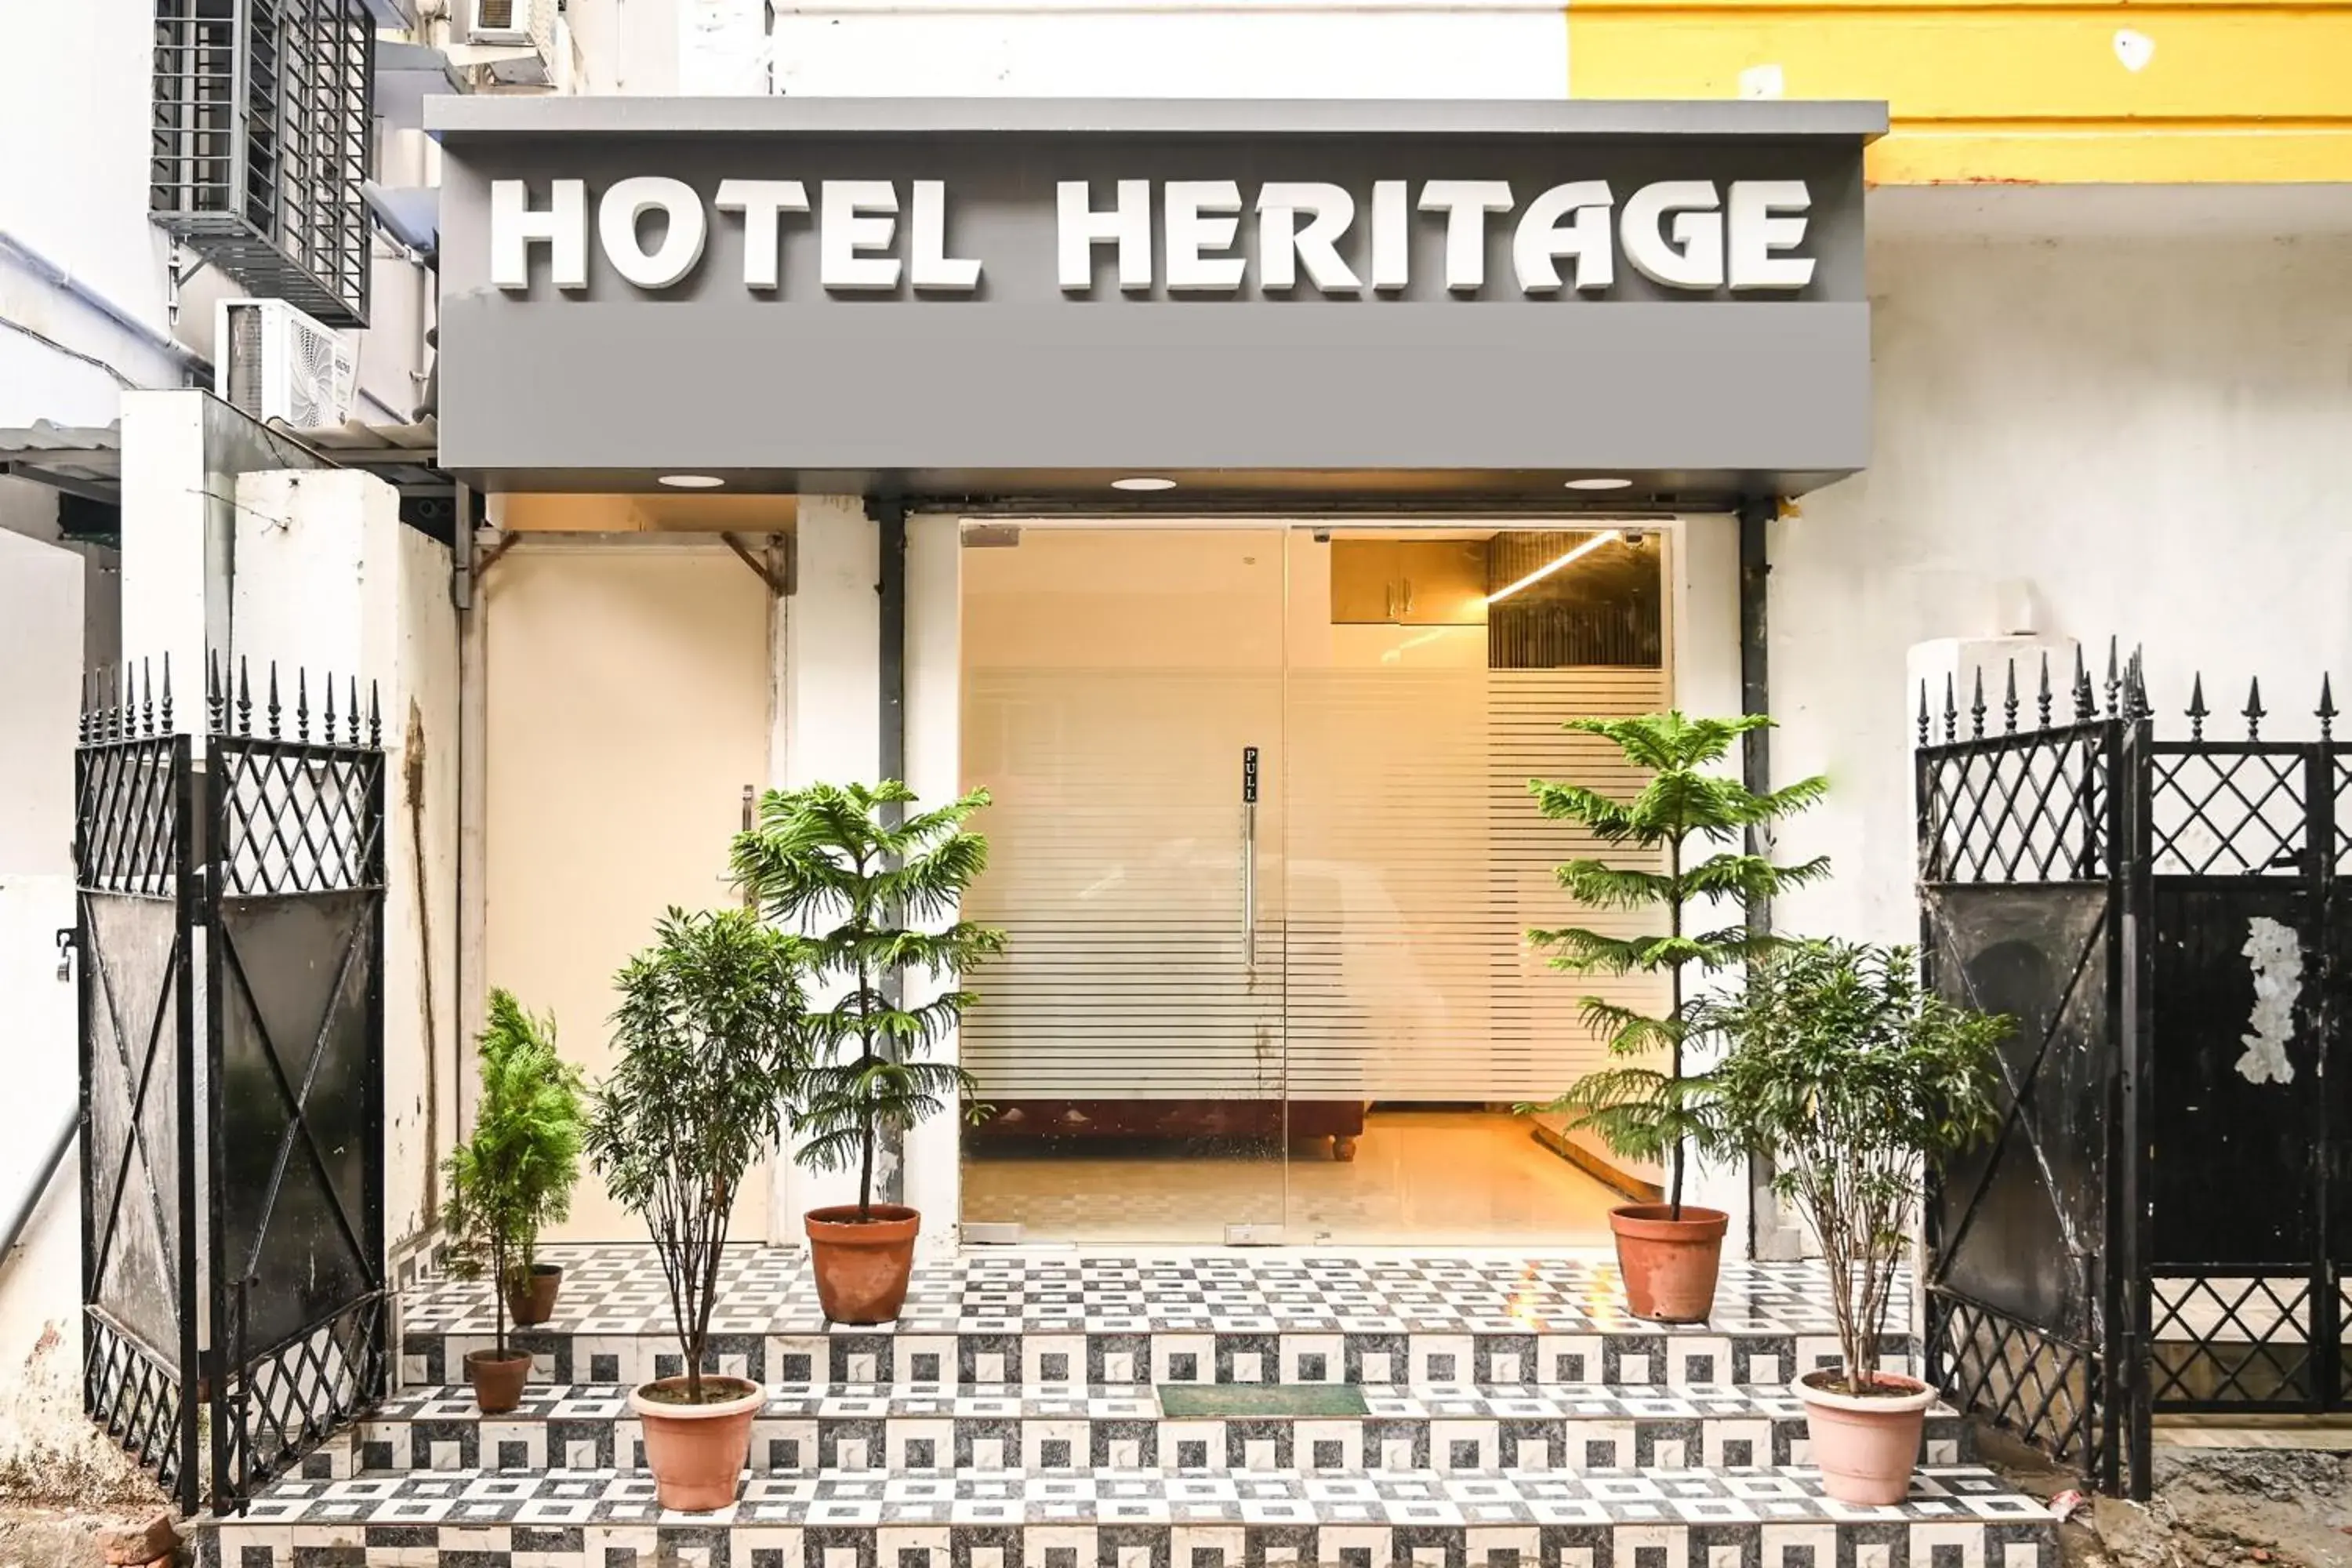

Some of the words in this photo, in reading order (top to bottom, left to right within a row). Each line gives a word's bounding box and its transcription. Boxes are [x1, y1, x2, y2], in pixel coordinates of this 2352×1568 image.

[491, 176, 982, 290] HOTEL
[1056, 179, 1817, 293] HERITAGE
[1246, 750, 1256, 800] PULL
